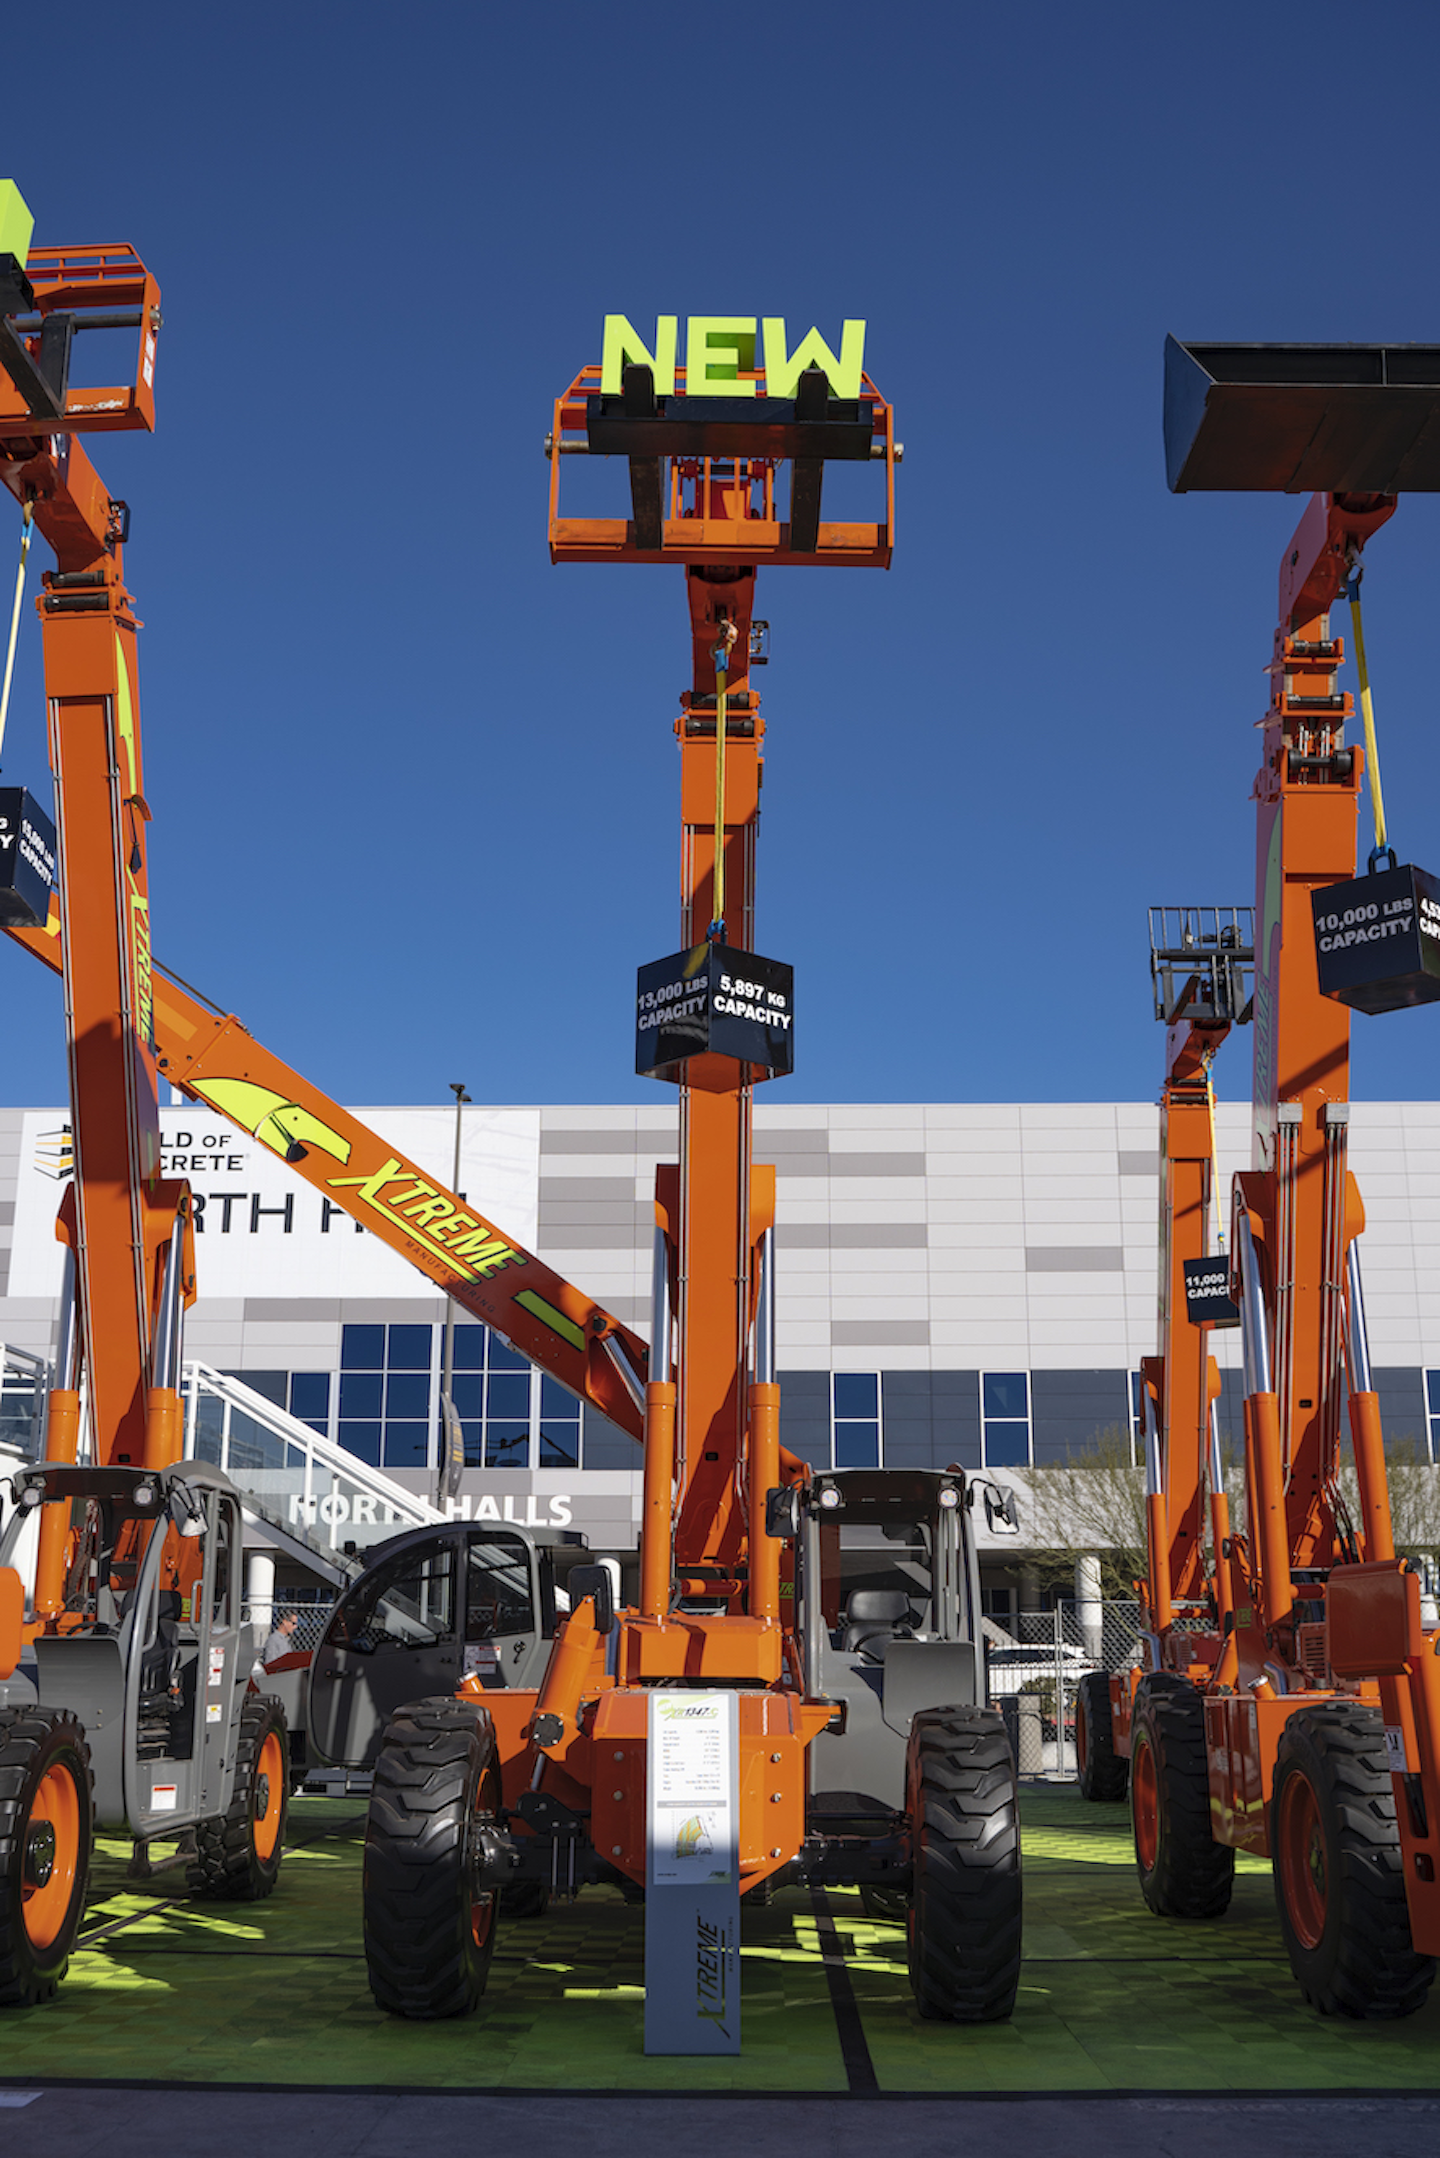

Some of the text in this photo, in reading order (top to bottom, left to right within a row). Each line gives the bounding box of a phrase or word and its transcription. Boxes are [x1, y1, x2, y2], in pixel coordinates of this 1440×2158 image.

[601, 314, 866, 399] NEW
[19, 839, 52, 887] CAPACITY
[1316, 897, 1413, 933] 10,000 LBS
[1318, 915, 1413, 953] CAPACITY
[126, 863, 153, 1043] XTREME
[638, 975, 709, 1011] 13,000 LBS
[720, 973, 786, 1008] 5,897 KG
[638, 994, 707, 1031] CAPACITY
[714, 995, 792, 1030] CAPACITY
[202, 1135, 231, 1148] OF
[325, 1157, 528, 1284] XTREME
[405, 1240, 496, 1313] MANUFACTURING
[1186, 1272, 1225, 1288] 11,000
[1187, 1285, 1230, 1299] CAPACI
[446, 1494, 572, 1527] HALLS
[697, 1914, 731, 2040] XTREME
